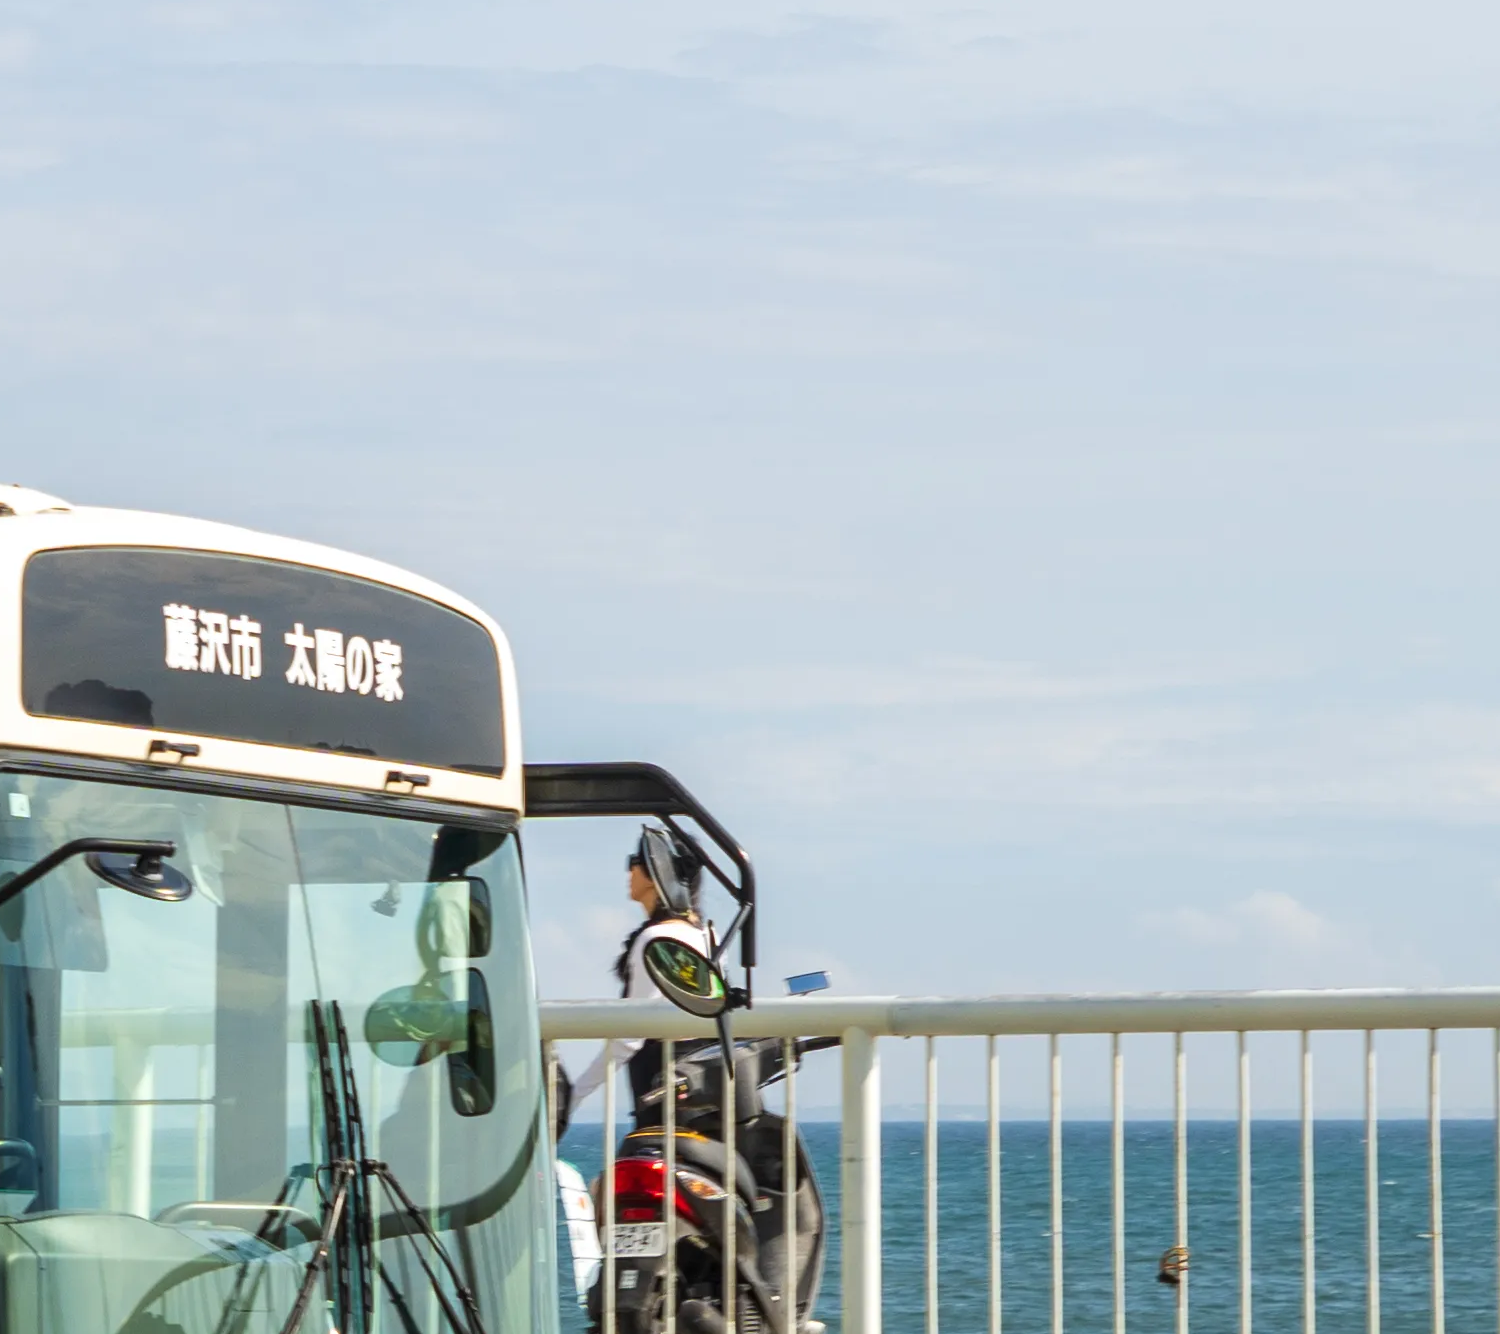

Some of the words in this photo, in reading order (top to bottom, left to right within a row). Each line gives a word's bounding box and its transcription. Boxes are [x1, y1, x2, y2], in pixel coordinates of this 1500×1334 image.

[162, 602, 263, 681] 藤沢市
[283, 622, 405, 703] 太陽の家
